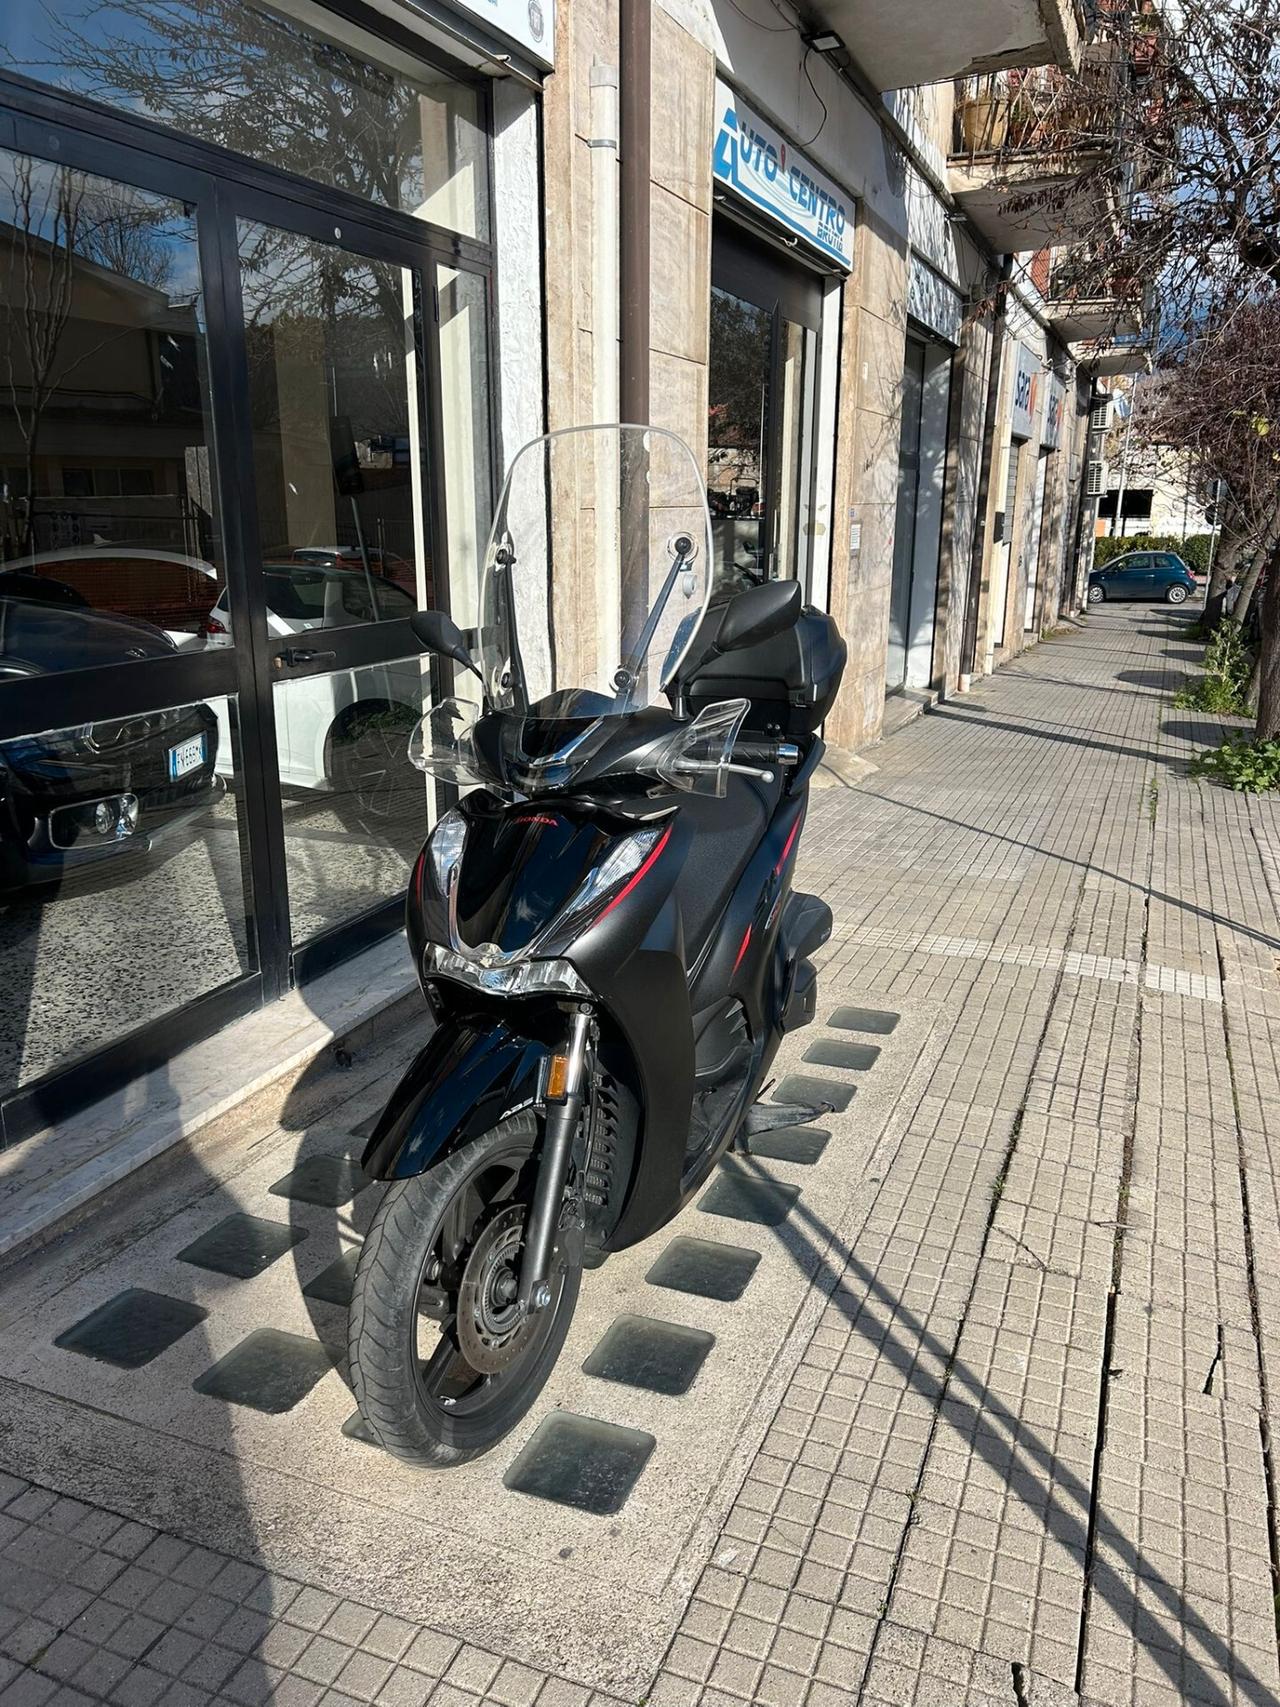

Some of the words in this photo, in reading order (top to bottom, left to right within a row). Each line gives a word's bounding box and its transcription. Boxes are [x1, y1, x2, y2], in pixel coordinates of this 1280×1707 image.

[713, 107, 778, 182] AUTO
[790, 166, 846, 236] CENTRO
[512, 815, 559, 828] HONDA
[499, 1096, 534, 1120] ABS
